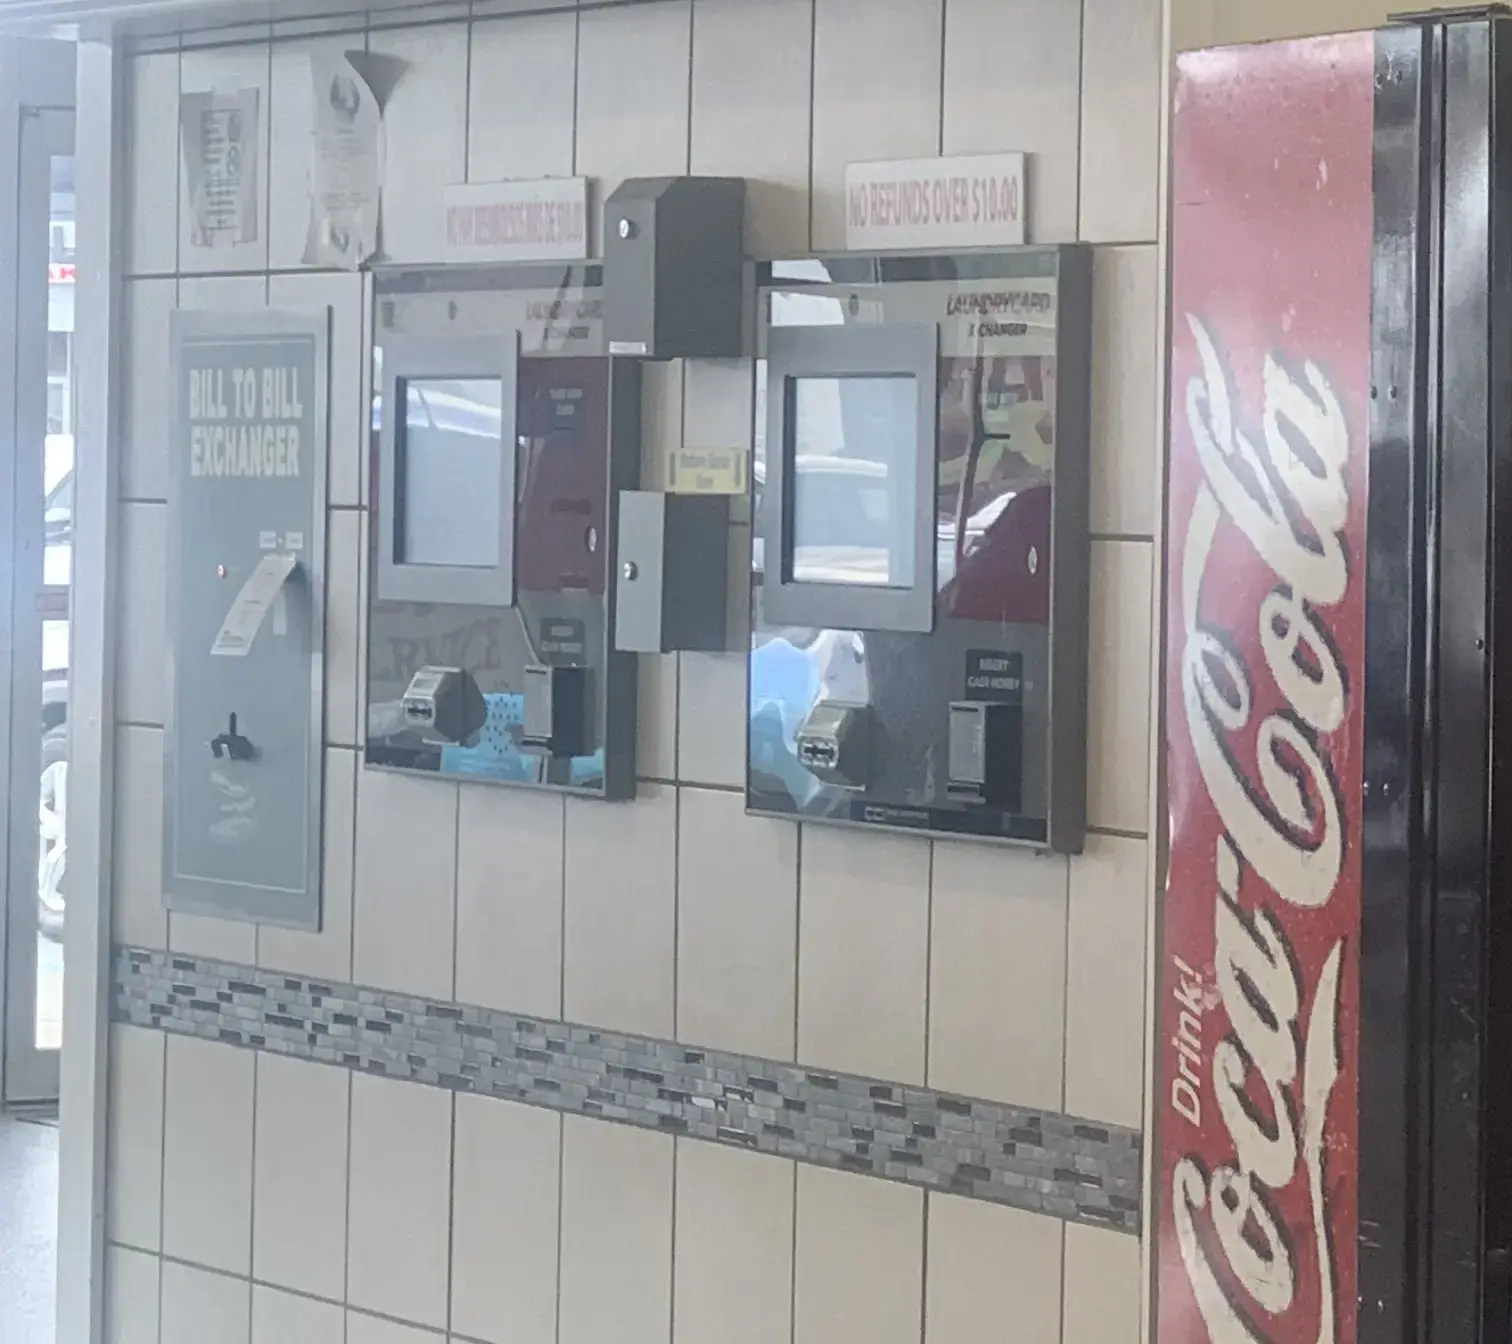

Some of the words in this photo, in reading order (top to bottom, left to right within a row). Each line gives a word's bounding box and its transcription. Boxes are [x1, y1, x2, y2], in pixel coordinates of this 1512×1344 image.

[869, 179, 930, 226] REFUNDS
[932, 176, 969, 225] OVER
[972, 174, 1018, 227] $10.00
[189, 367, 228, 419] BILL
[232, 366, 256, 419] TO
[262, 365, 303, 419] BILL
[190, 423, 300, 478] EXCHANGER
